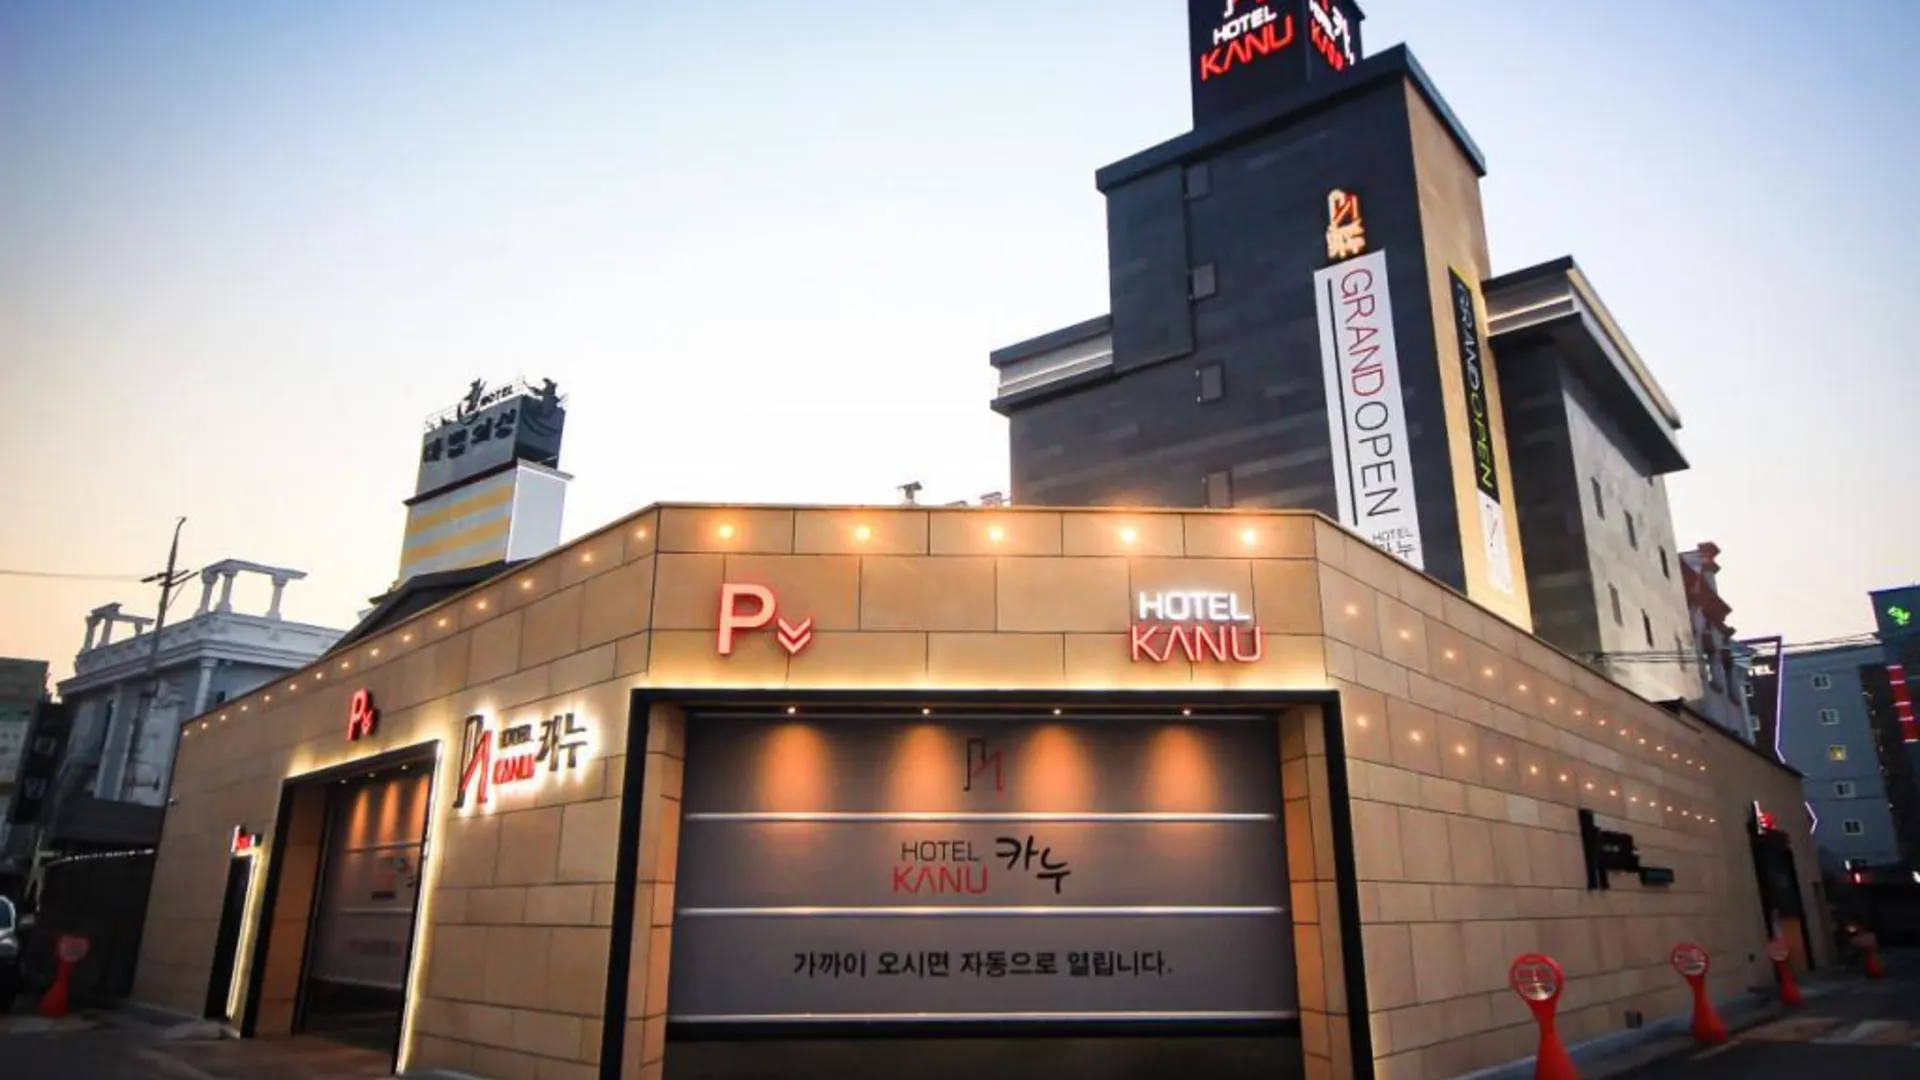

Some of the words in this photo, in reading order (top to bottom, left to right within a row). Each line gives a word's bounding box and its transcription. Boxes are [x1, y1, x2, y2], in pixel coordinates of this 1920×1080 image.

[1200, 14, 1295, 82] KANU
[1212, 5, 1277, 46] HOTEL
[1341, 268, 1386, 397] GRAND
[1456, 282, 1480, 390] GRAND
[1471, 391, 1493, 488] OPEN
[1354, 400, 1401, 517] OPEN
[1372, 527, 1414, 541] HOTEL
[718, 583, 776, 654] P
[1138, 591, 1252, 621] HOTEL
[1131, 624, 1262, 662] KANU
[536, 713, 587, 773] 카누
[901, 841, 980, 862] HOTEL
[995, 834, 1071, 894] 카누
[893, 866, 988, 893] KANU
[793, 950, 866, 978] 가까이
[876, 951, 950, 978] 오시면
[959, 951, 1058, 978] 자동으로
[1066, 950, 1174, 978] 열립니다.
